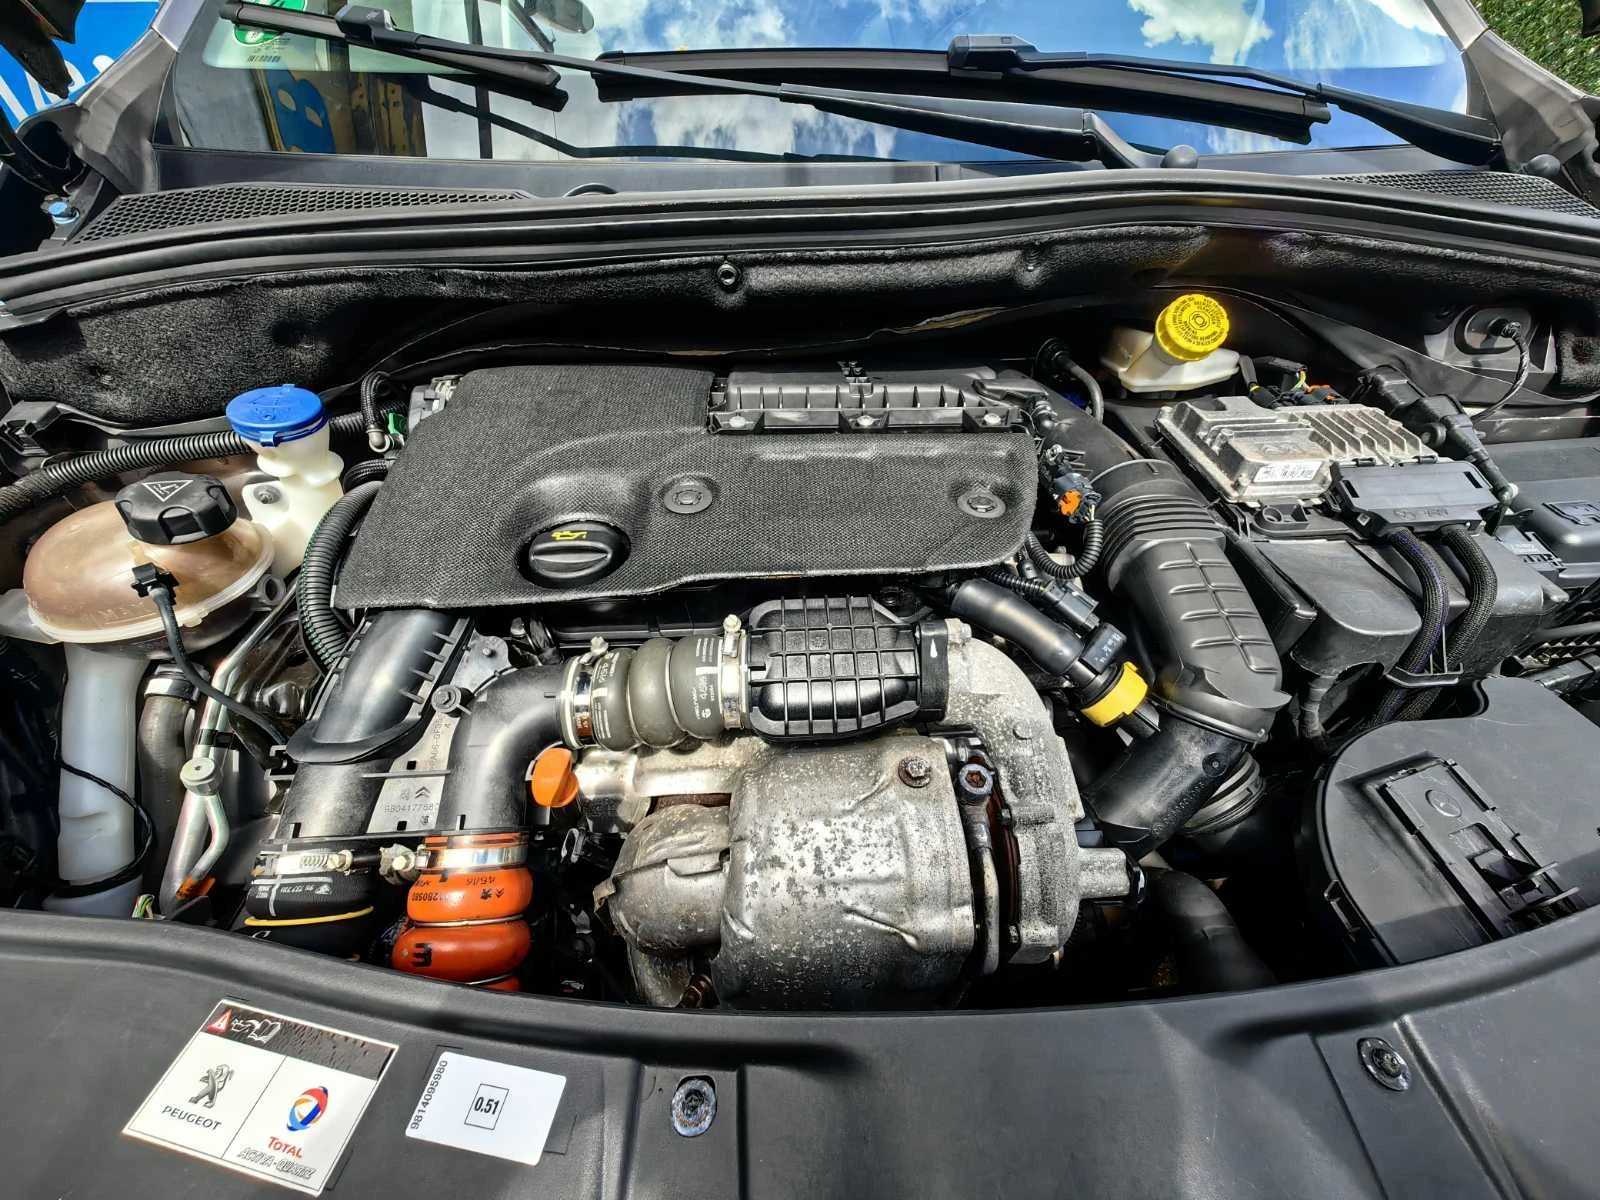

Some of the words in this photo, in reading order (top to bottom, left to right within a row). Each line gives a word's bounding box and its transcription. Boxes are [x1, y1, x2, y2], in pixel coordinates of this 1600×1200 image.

[410, 1060, 448, 1130] 9814095980
[474, 1097, 499, 1115] 0.51
[161, 1105, 222, 1131] PEUGEOT
[268, 1136, 304, 1158] TOTAL
